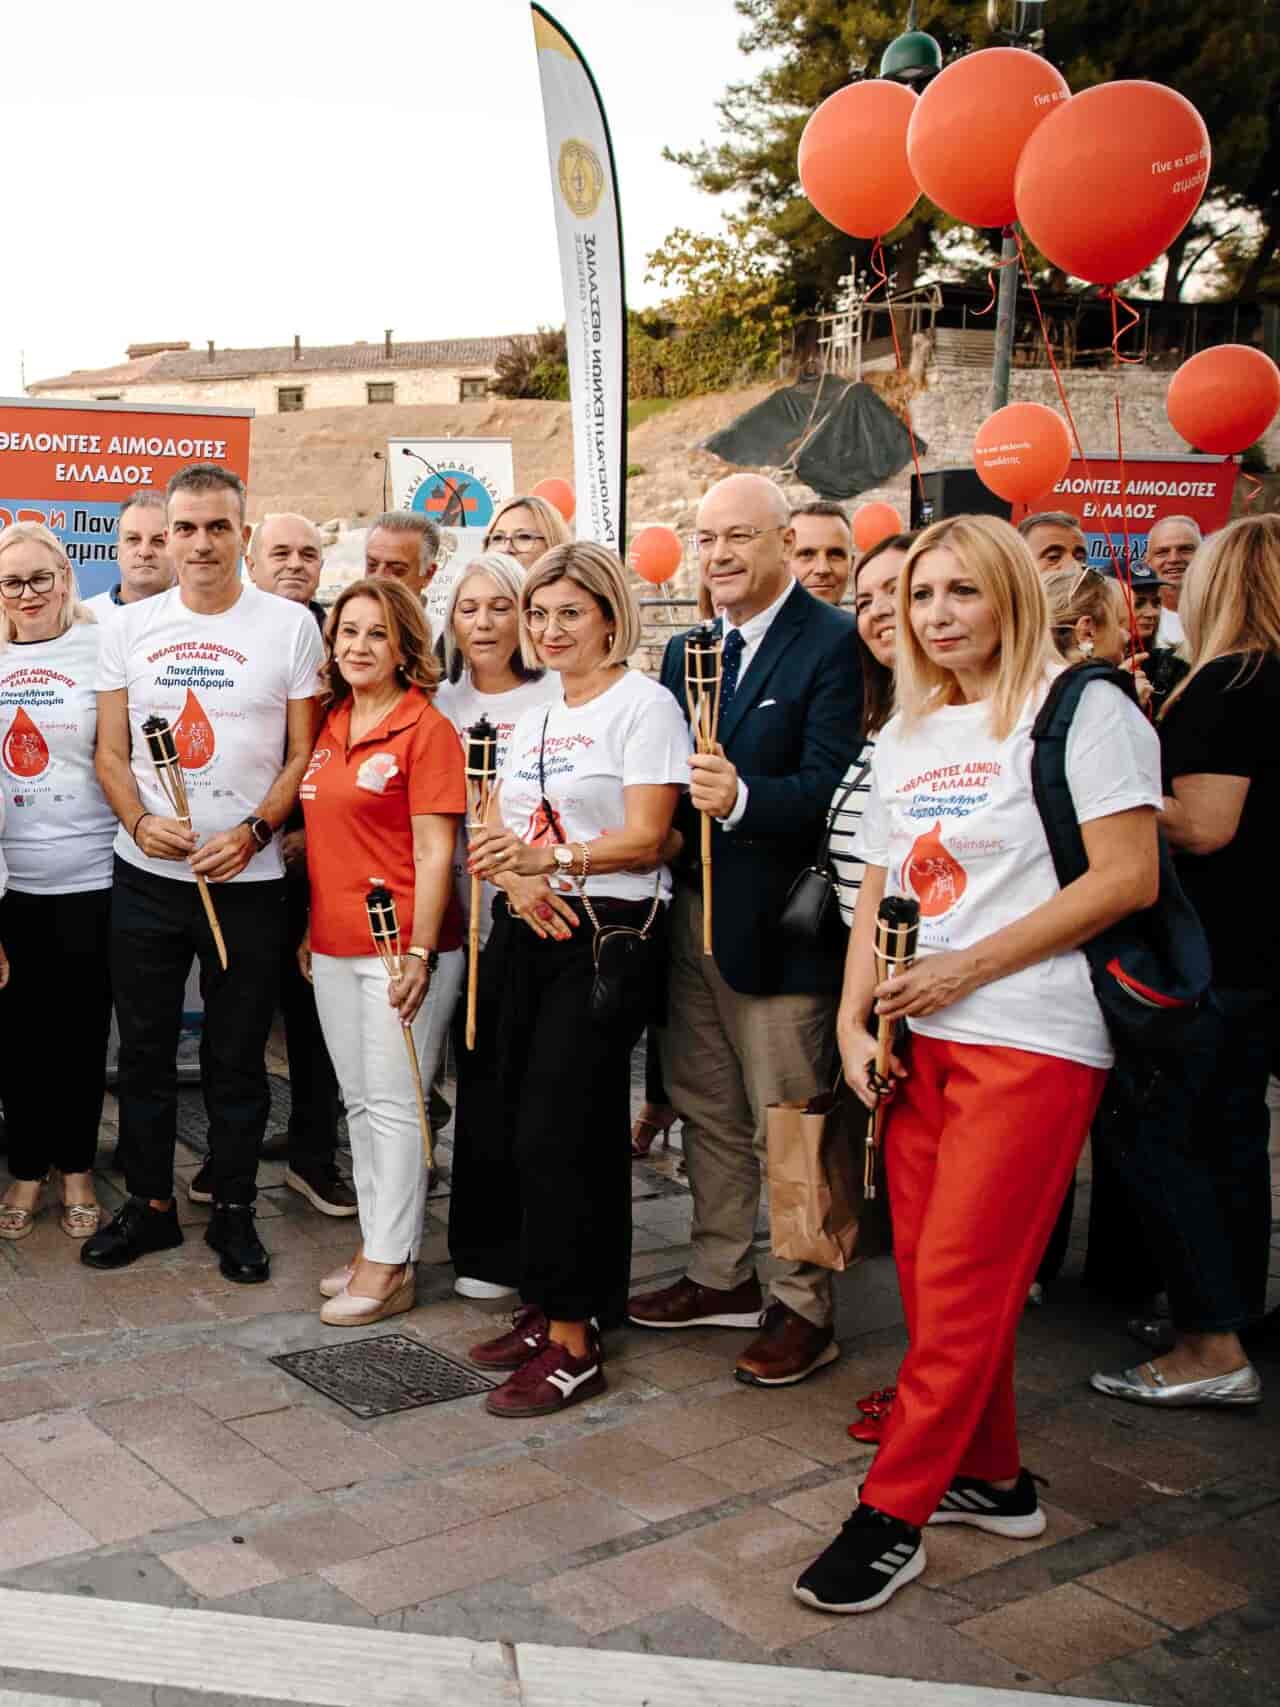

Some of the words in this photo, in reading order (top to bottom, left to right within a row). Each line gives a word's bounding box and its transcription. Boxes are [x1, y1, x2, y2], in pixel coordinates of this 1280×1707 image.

[107, 436, 227, 458] ΑΙΜΟΔΟΤΕΣ
[55, 464, 153, 485] ΕΛΛΑΔΟΣ
[1053, 479, 1120, 494] ΕΛΟΝΤΕΣ
[1125, 481, 1216, 497] ΑΙΜΟΔΟΤΕΣ
[147, 642, 197, 663] ΕΘΕΛΟΝΤΕΣ
[199, 642, 247, 664] ΑΙΜΟΔΟΤΕΣ
[175, 652, 220, 661] ΕΛΛΑΔΑΣ
[166, 665, 224, 676] Πανελλήνια
[154, 676, 234, 690] Λαμπαδηδρομία
[932, 776, 989, 792] ΕΛΛΑΔΑΣ
